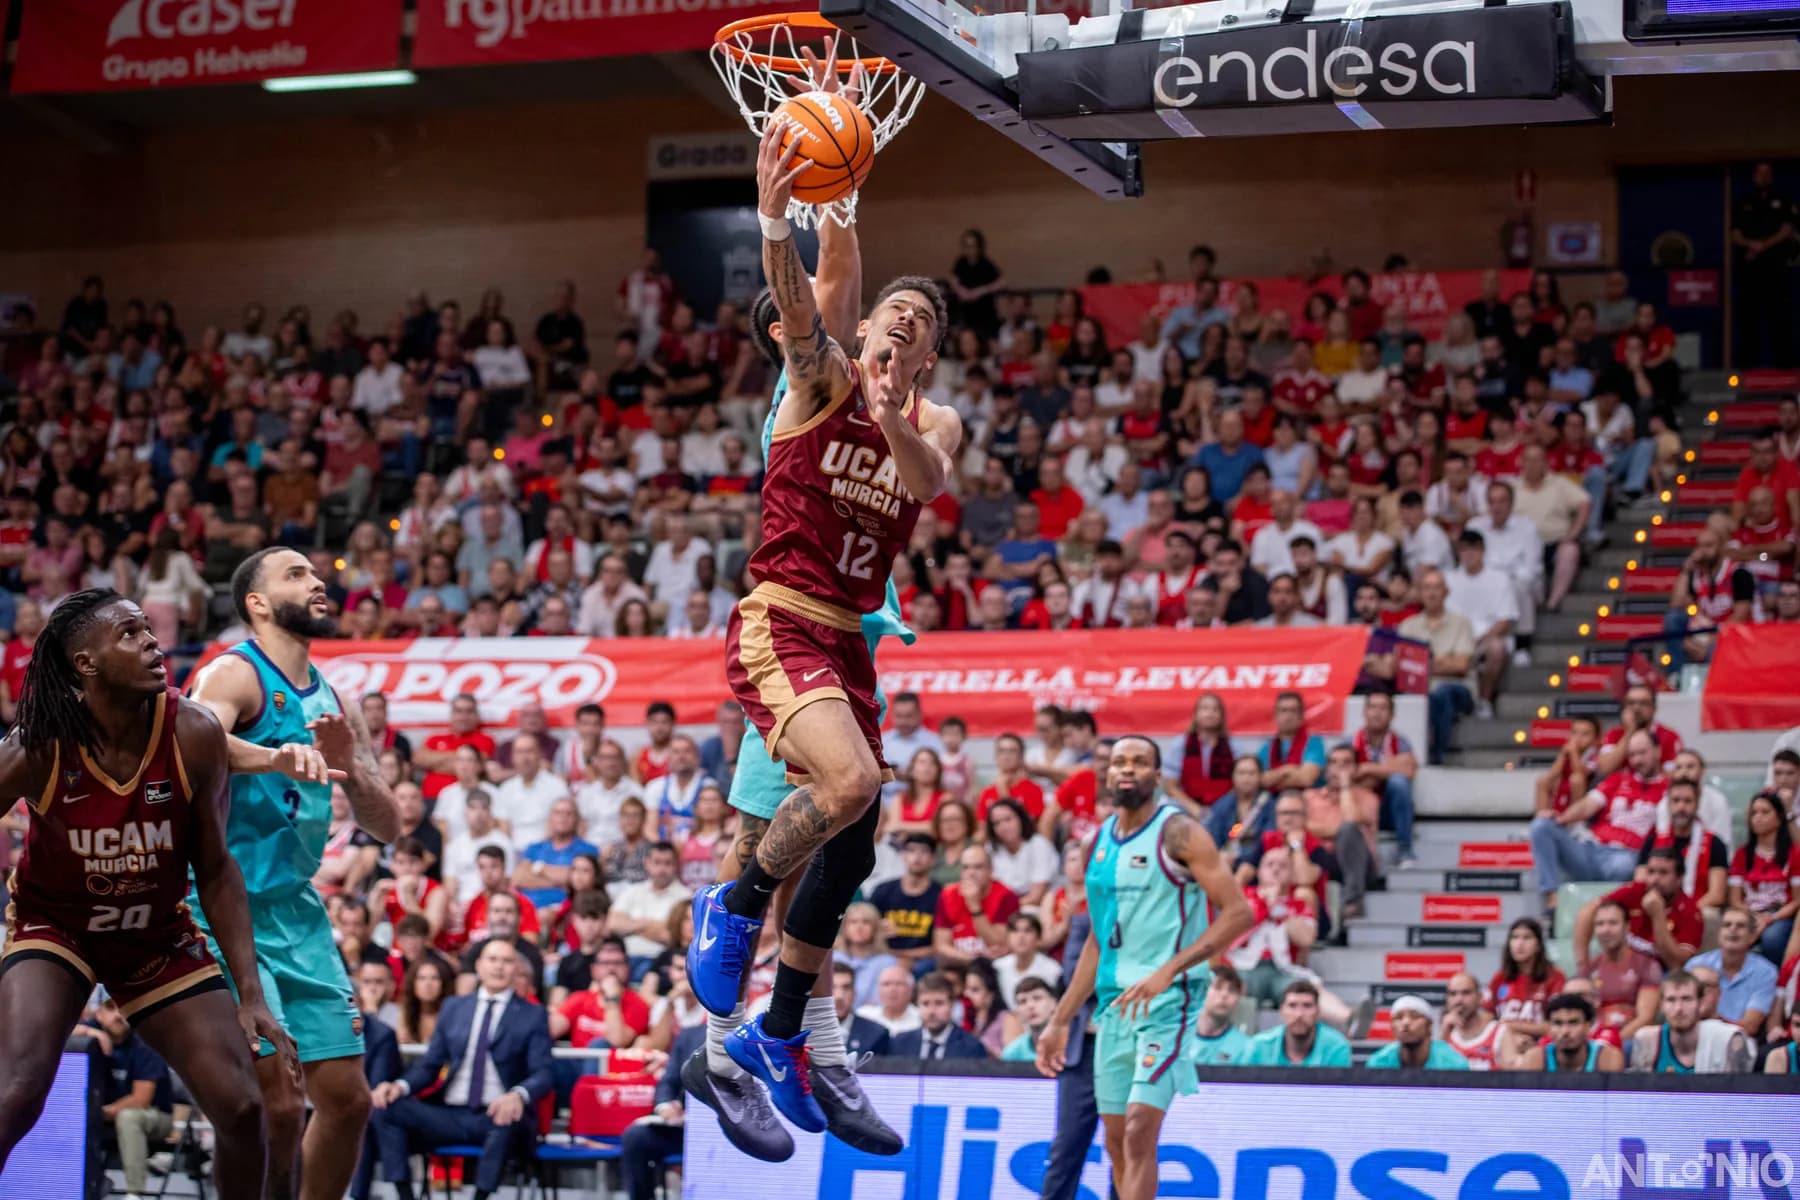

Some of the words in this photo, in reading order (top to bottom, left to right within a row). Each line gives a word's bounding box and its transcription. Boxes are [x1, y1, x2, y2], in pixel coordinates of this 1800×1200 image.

[102, 54, 189, 86] Grupo
[1153, 29, 1477, 108] endesa
[830, 477, 900, 520] MURCIA
[836, 531, 880, 581] 12
[876, 667, 1075, 694] STRELLA
[1117, 663, 1331, 691] LEVANTE
[67, 819, 174, 858] UCAM
[84, 854, 160, 874] MURCIA
[86, 904, 153, 932] 20
